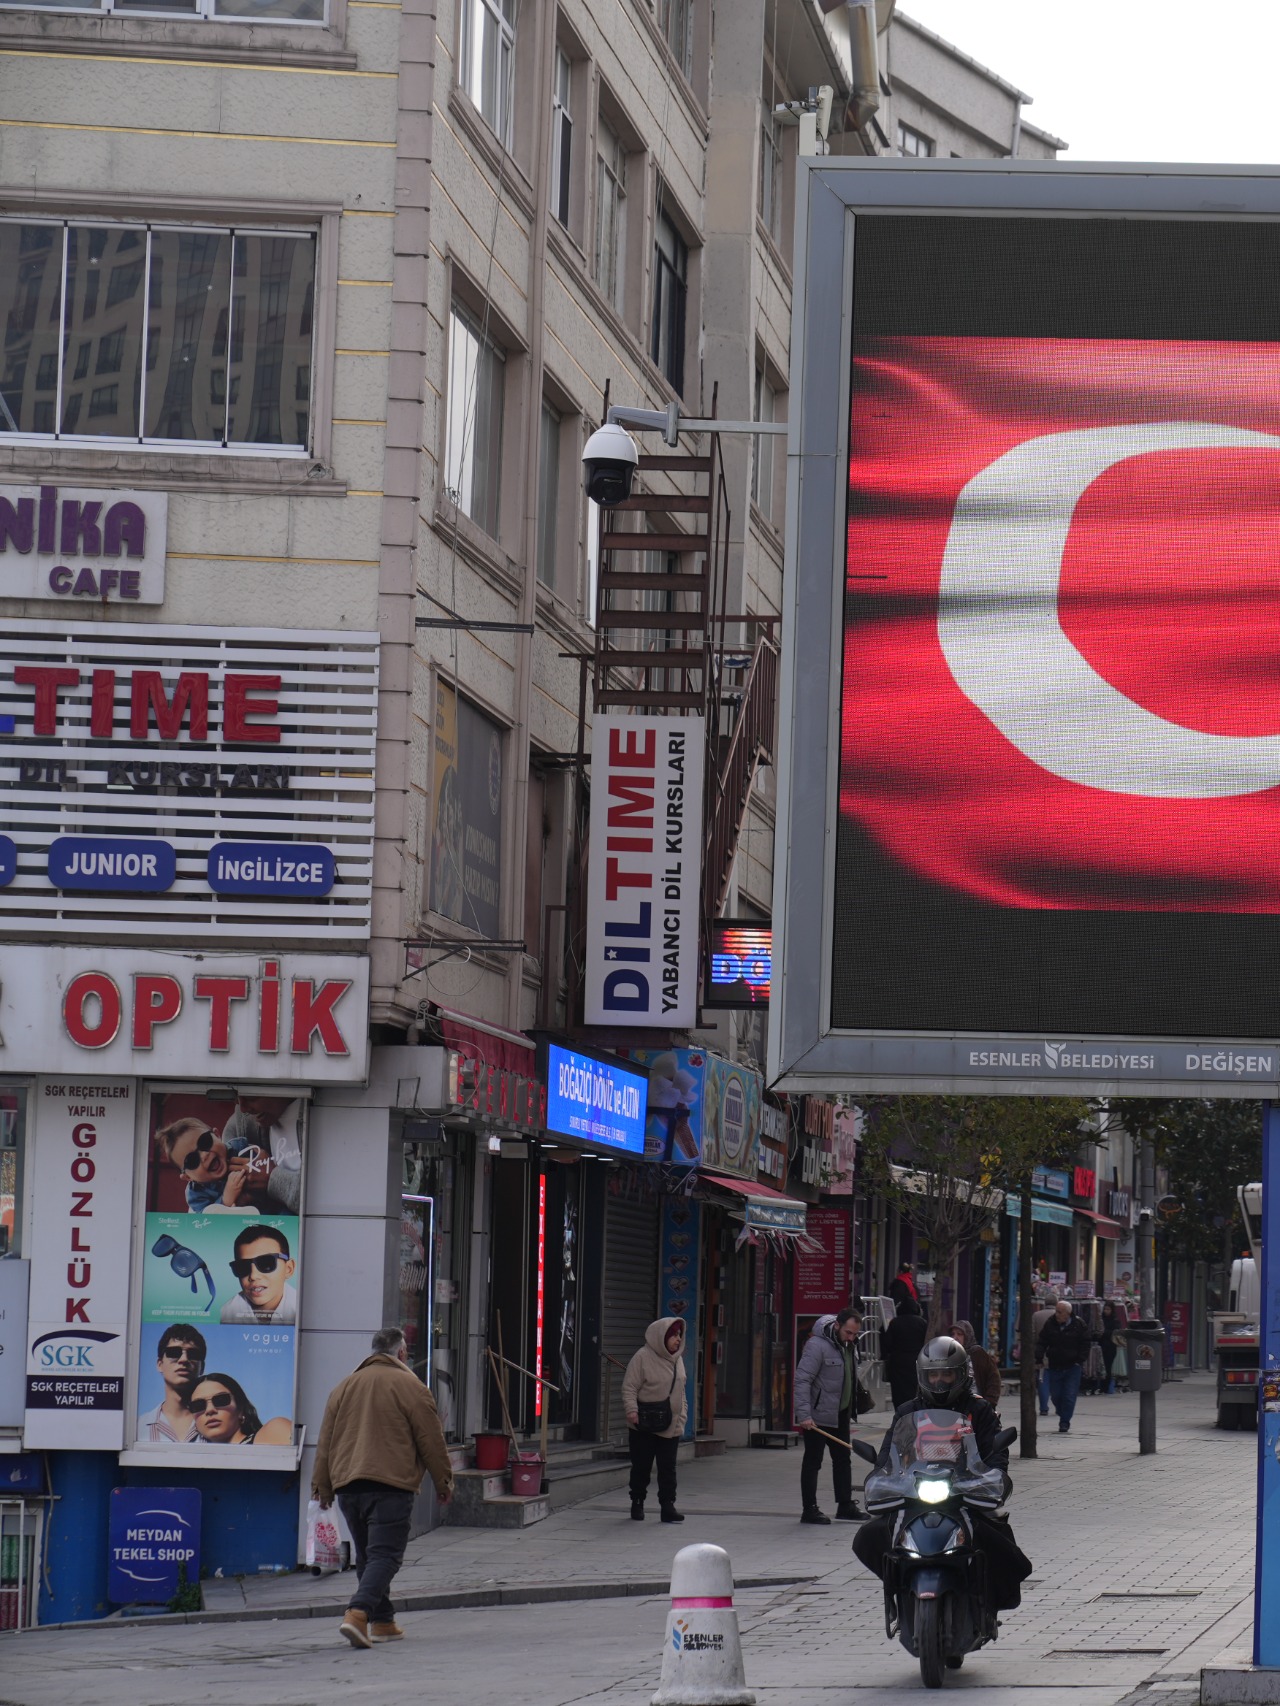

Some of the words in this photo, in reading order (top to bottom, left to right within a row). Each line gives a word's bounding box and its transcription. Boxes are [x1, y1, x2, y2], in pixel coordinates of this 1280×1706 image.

[49, 566, 140, 598] CAFE
[0, 666, 282, 742] TIME
[107, 760, 293, 789] KURSLARI
[665, 731, 685, 854] KURSLARI
[65, 852, 158, 877] JUNIOR
[217, 856, 324, 883] İNGİLİZCE
[661, 861, 682, 900] DİL
[661, 908, 681, 1014] YABANCI
[62, 957, 354, 1056] OPTİK
[969, 1052, 1041, 1067] ESENLER
[1186, 1052, 1271, 1075] DEĞİŞEN
[45, 1085, 65, 1096] SGK
[69, 1085, 129, 1099] REÇETELERİ
[67, 1105, 106, 1117] YAPILIR
[238, 1137, 301, 1174] Ray-Ban
[65, 1123, 97, 1323] GÖZLÜK
[243, 1333, 289, 1344] vogue
[41, 1344, 95, 1366] SGK
[31, 1382, 53, 1392] SGK
[55, 1381, 119, 1394] REÇETELERİ
[54, 1395, 95, 1406] YAPILIR
[127, 1529, 182, 1542] MEYDAN
[114, 1548, 155, 1560] TEKEL
[157, 1549, 195, 1561] SHOP
[684, 1634, 723, 1642] ESENLER
